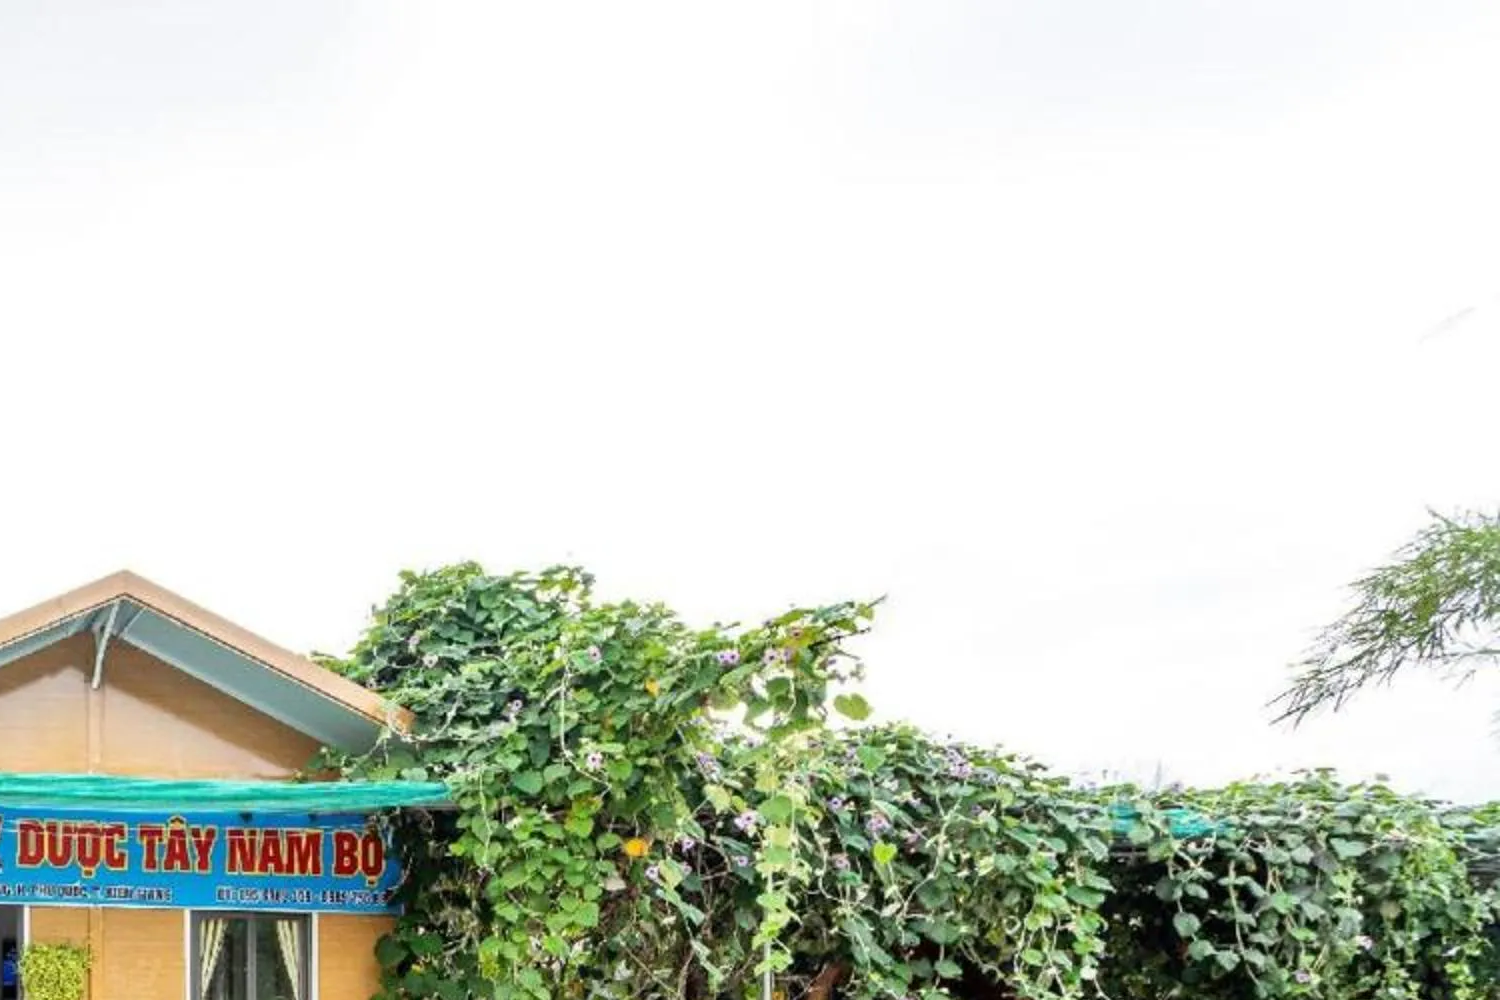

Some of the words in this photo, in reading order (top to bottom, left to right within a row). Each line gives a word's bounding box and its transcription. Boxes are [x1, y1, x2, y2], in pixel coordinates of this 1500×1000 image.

[16, 818, 128, 879] DƯỢC
[138, 815, 218, 874] TÂY
[227, 827, 324, 877] NAM
[332, 822, 386, 888] BỘ
